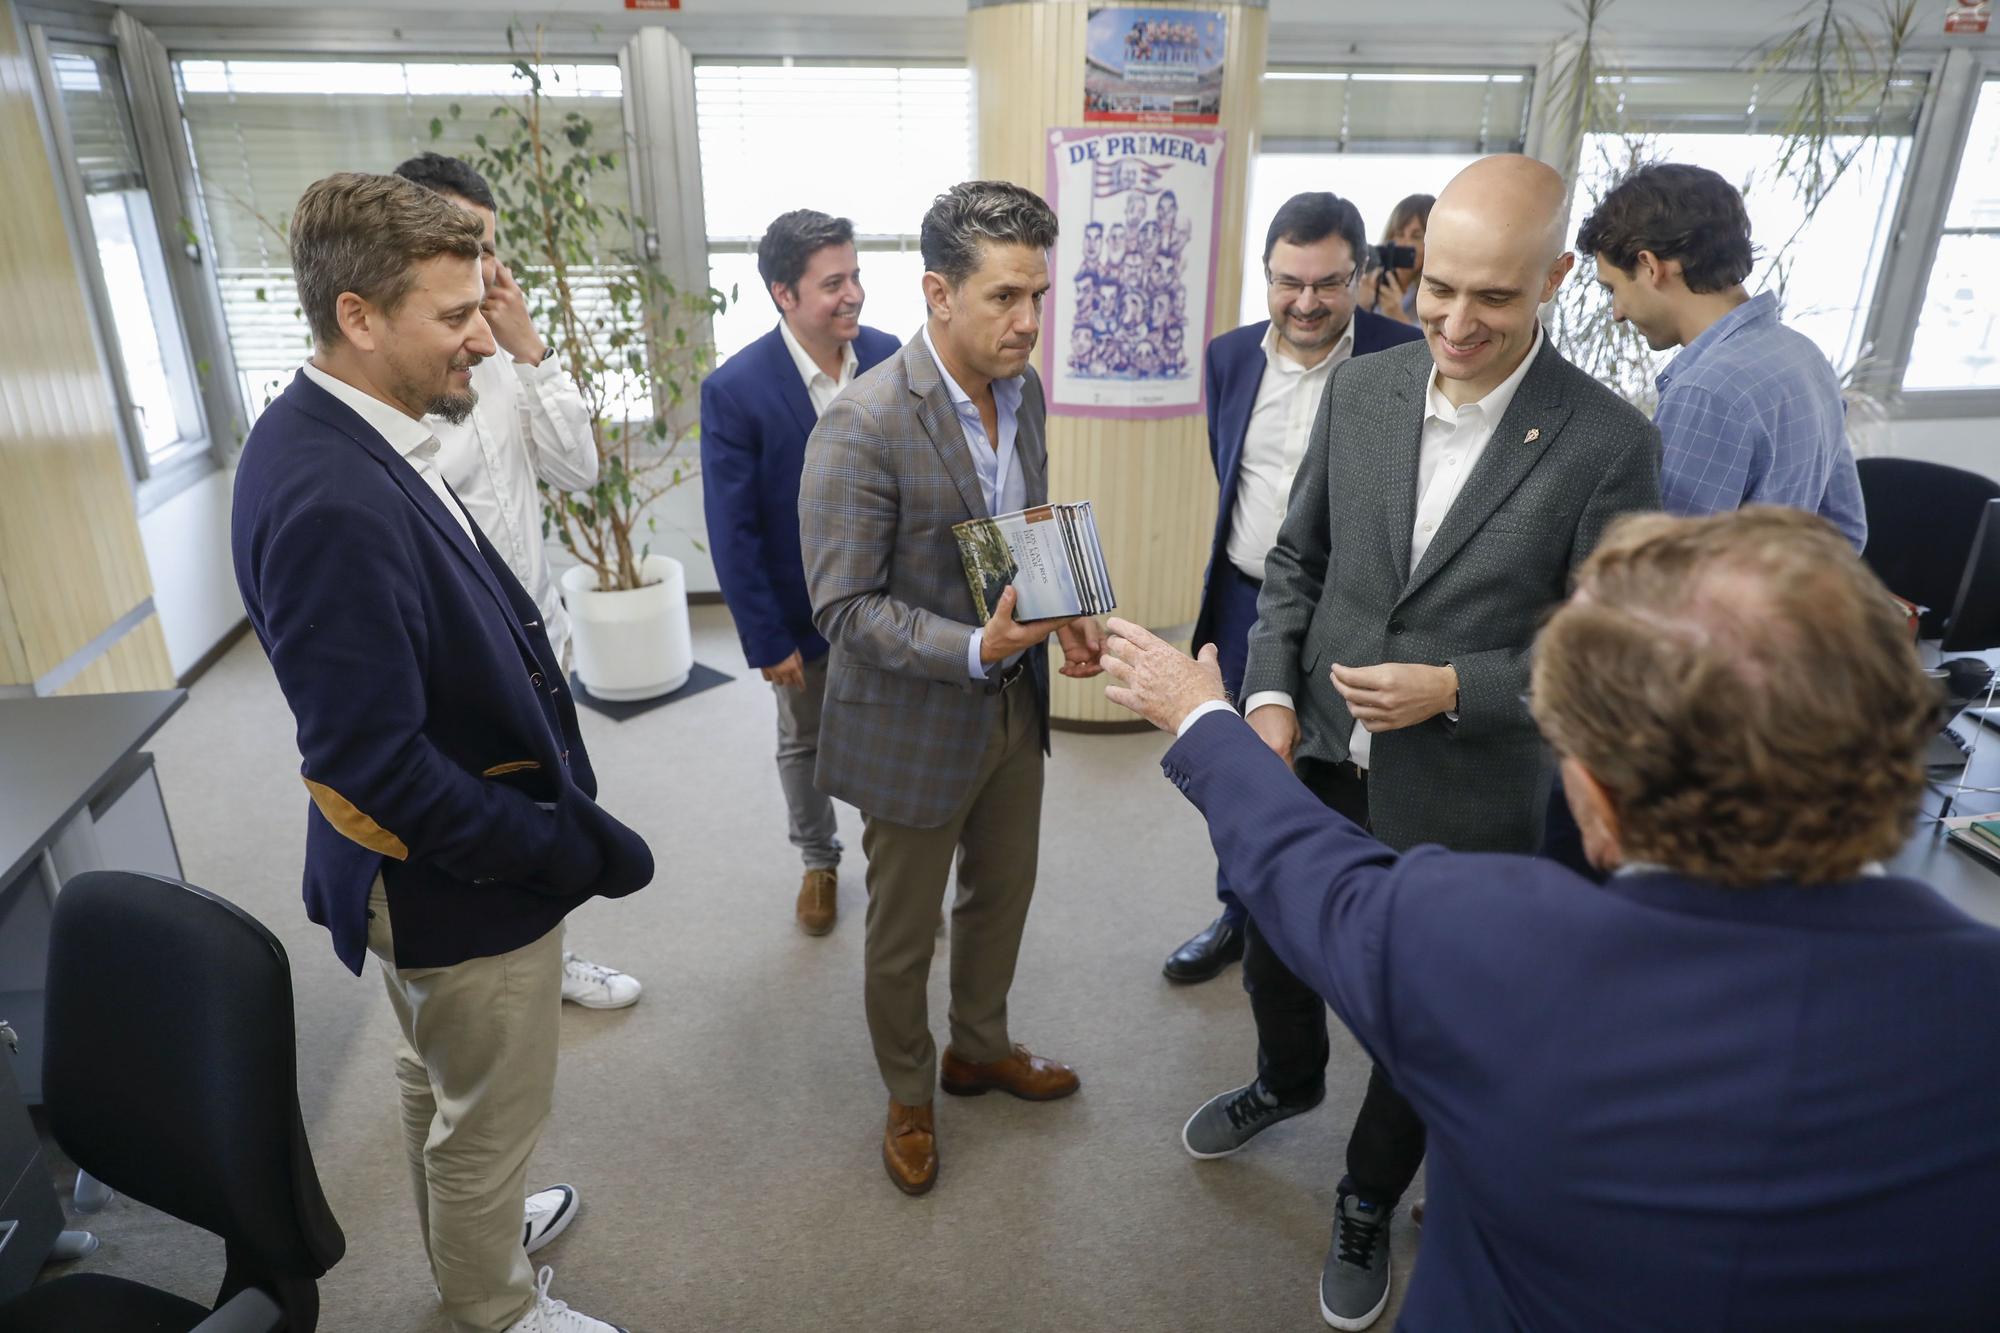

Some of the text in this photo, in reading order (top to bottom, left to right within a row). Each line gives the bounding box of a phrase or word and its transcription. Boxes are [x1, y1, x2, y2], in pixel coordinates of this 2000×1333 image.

[1069, 136, 1207, 166] DE PRIMERA
[1029, 548, 1039, 568] MAR
[1034, 546, 1048, 584] CASTROS
